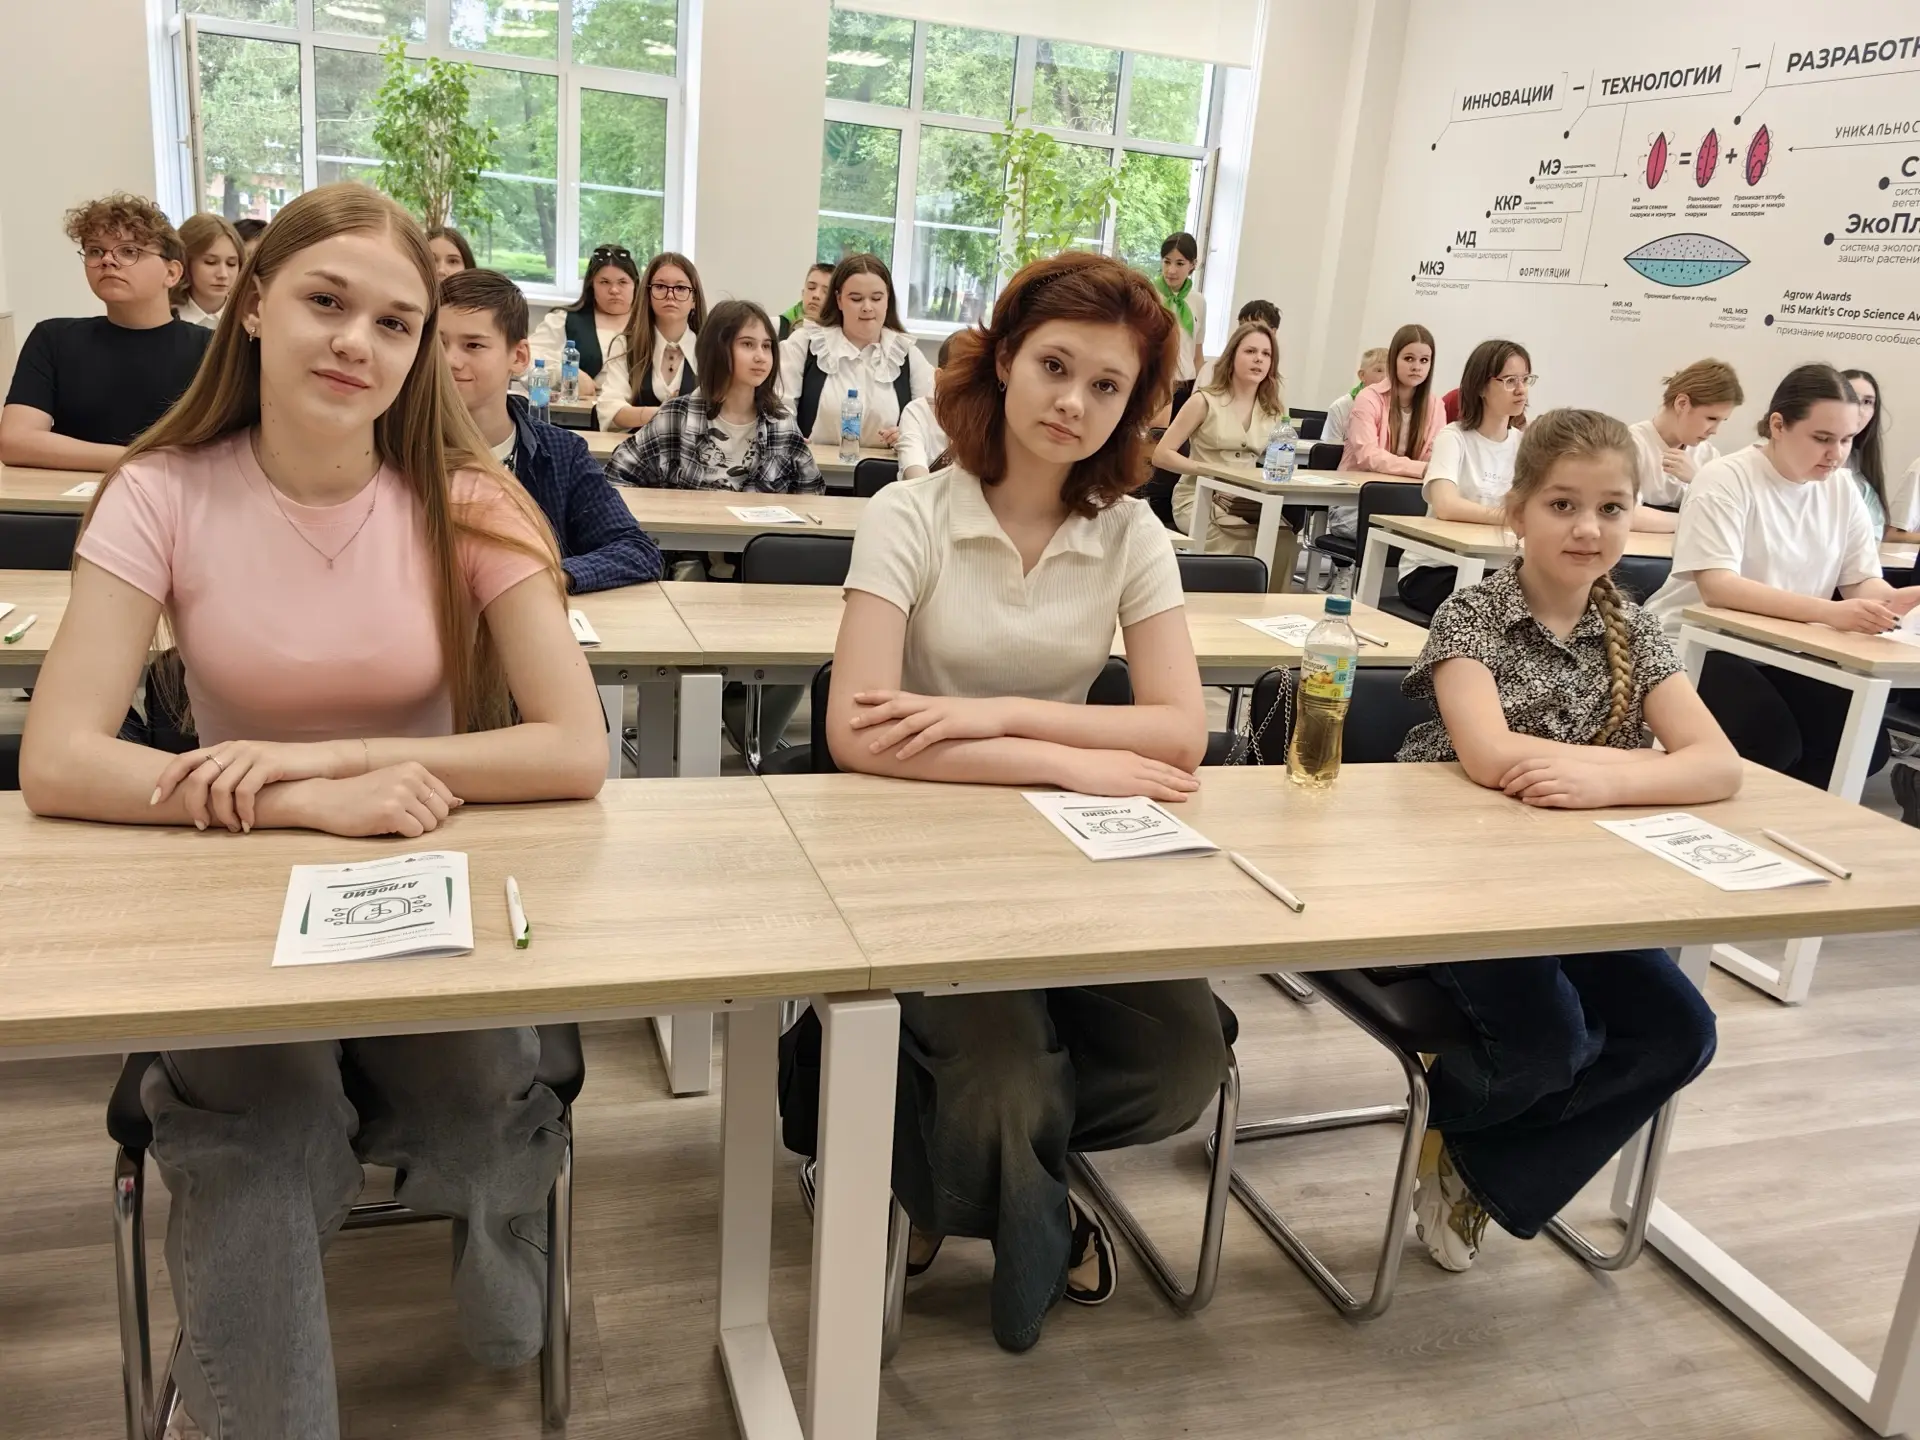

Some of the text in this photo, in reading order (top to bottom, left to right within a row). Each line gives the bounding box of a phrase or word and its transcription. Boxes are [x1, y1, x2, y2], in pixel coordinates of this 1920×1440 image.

[1462, 83, 1554, 111] ИННОВАЦИИ
[1601, 64, 1722, 96] ТЕХНОЛОГИИ
[1539, 159, 1561, 176] МЭ
[1494, 195, 1522, 211] ККР
[1455, 230, 1477, 248] МД
[1840, 244, 1879, 252] система
[1837, 255, 1875, 264] защиты
[1418, 260, 1445, 276] МКЭ
[1519, 267, 1571, 278] ФОРМУЛЯЦИИ
[1782, 289, 1852, 302] Agrow Awards
[1780, 304, 1796, 314] IHS
[1797, 305, 1835, 317] Markit's
[1837, 307, 1861, 320] Crop
[1862, 309, 1905, 321] Science
[1776, 326, 1825, 338] признание
[1826, 331, 1873, 342] мирового
[342, 881, 418, 899] АгроБИО
